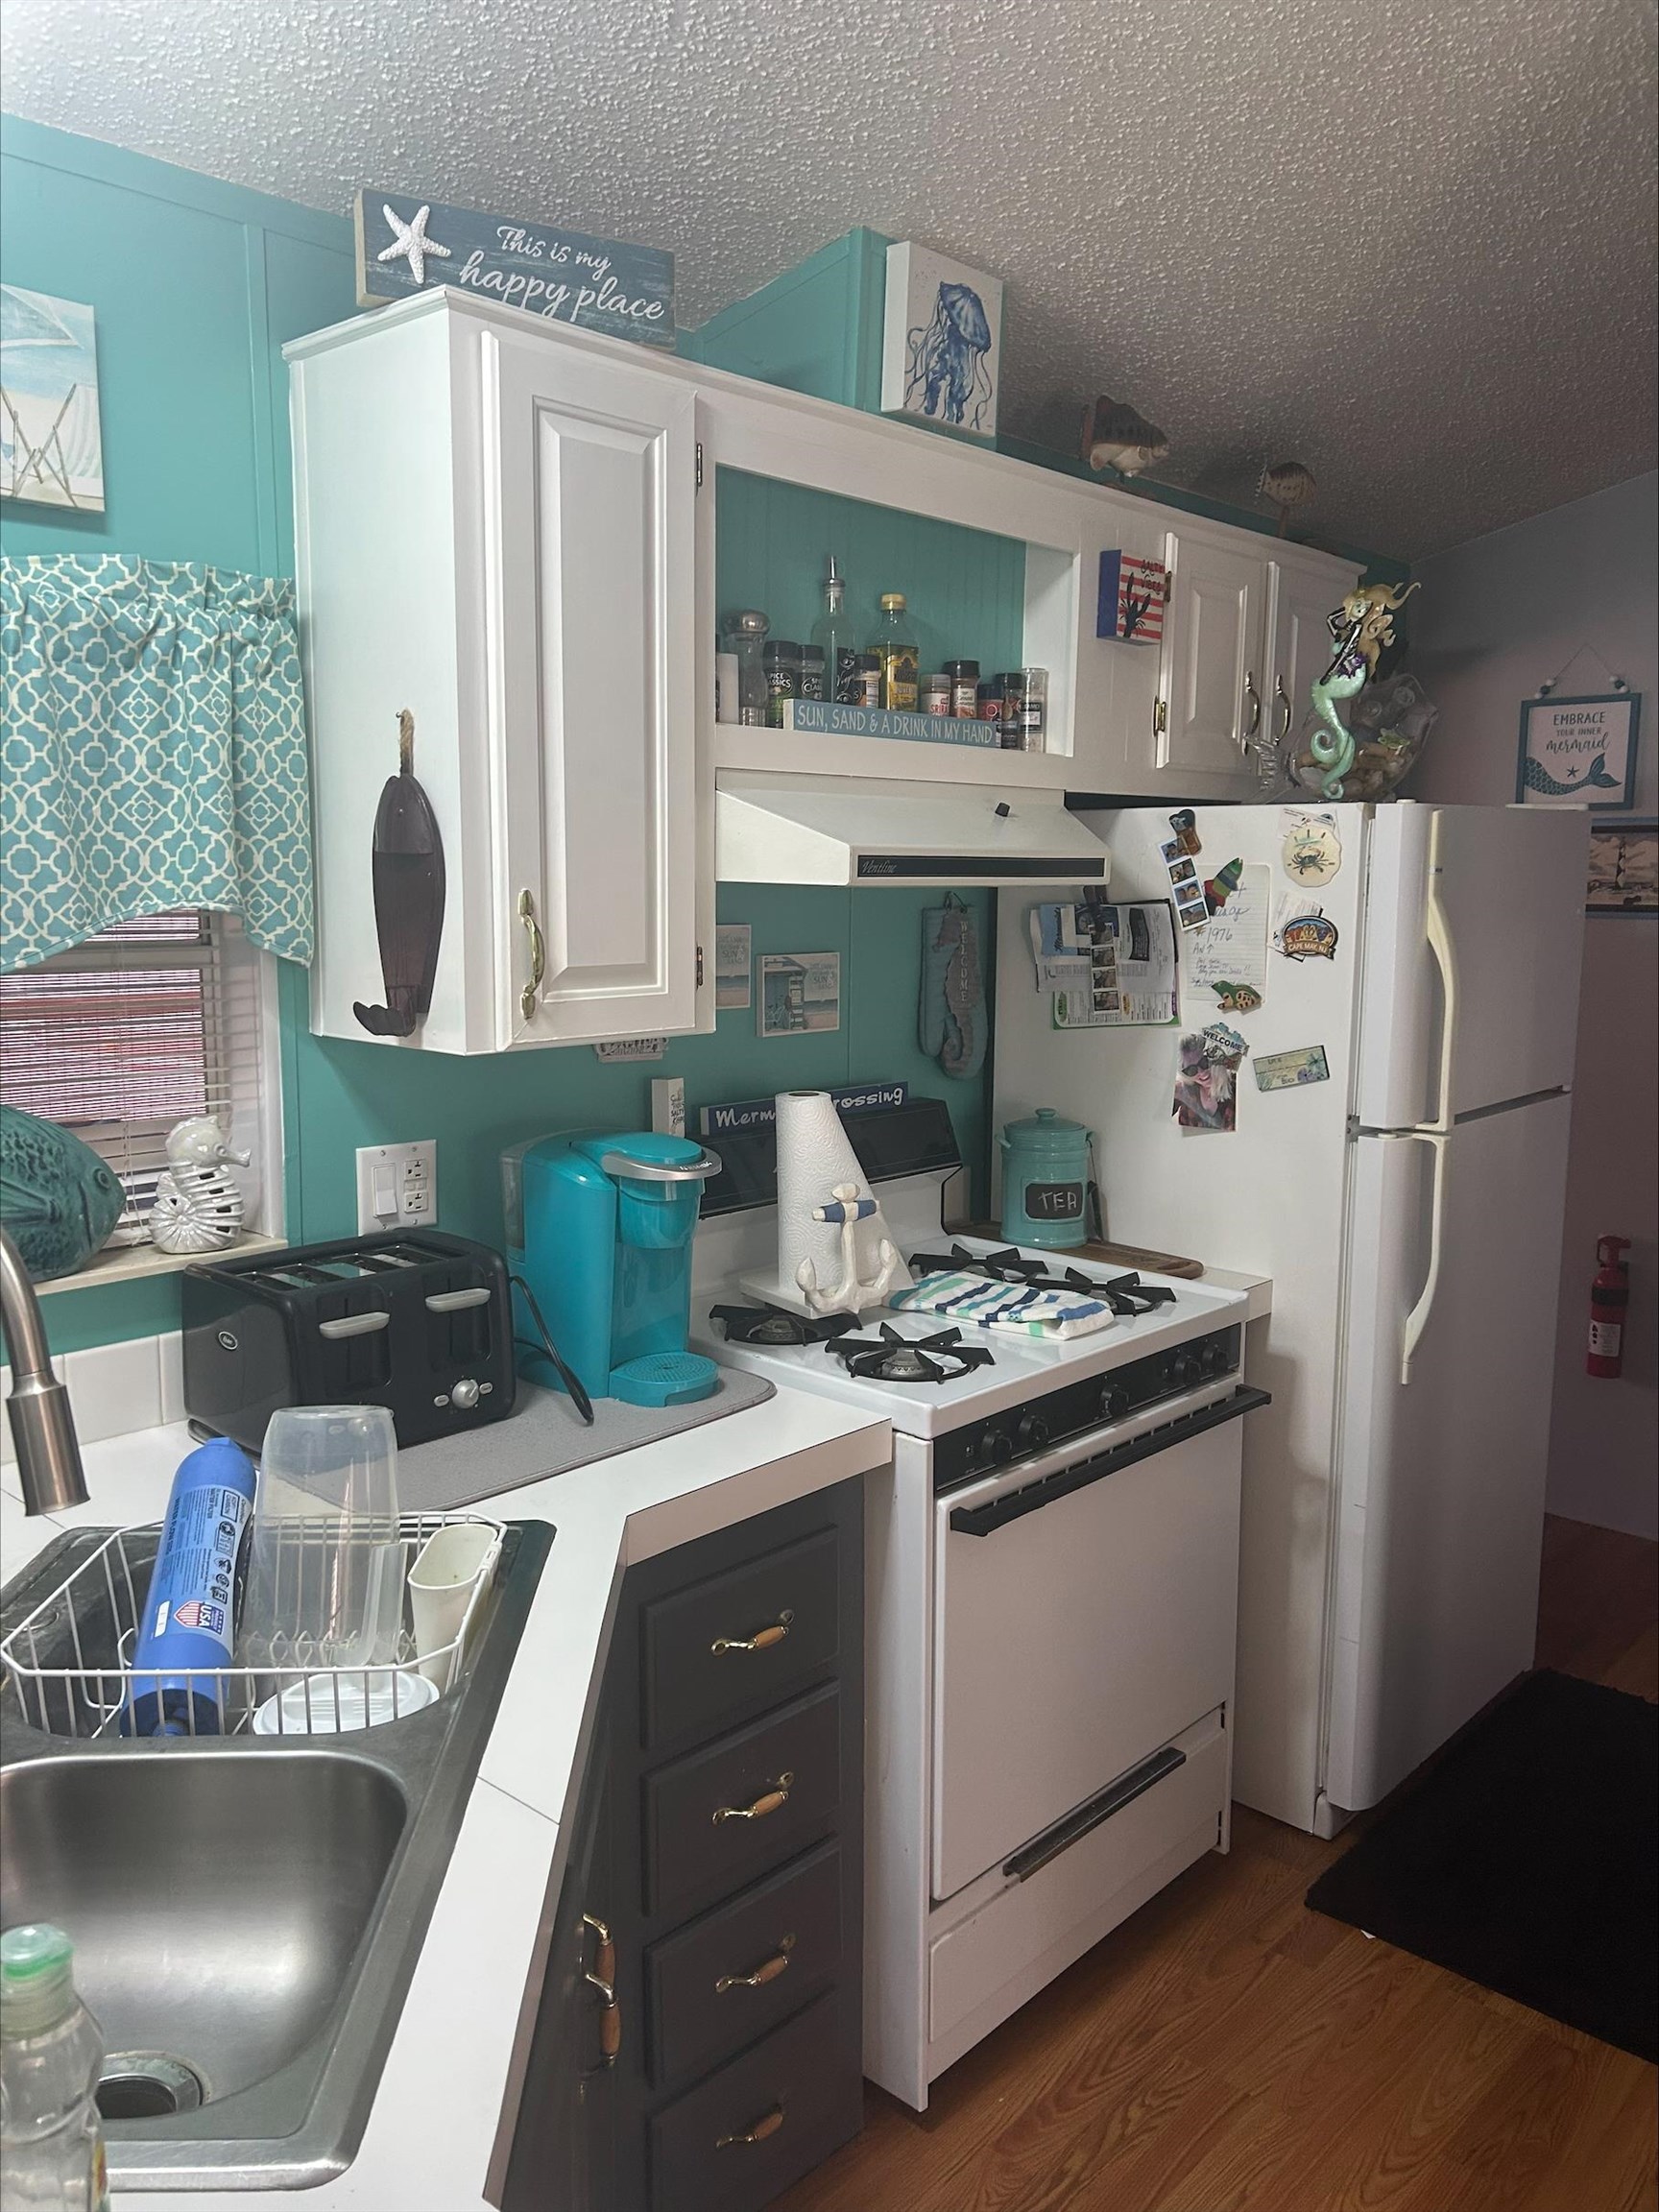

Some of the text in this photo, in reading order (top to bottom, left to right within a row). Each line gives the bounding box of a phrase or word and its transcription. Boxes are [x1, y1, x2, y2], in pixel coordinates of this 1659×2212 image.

[496, 225, 612, 281] This is my
[459, 251, 665, 323] happy place
[797, 705, 829, 733] SUN,
[831, 709, 866, 732] SAND
[870, 713, 878, 733] &
[881, 714, 891, 734] A
[894, 715, 928, 738] DRINK
[931, 722, 941, 738] IN
[944, 723, 960, 741] MY
[962, 725, 993, 744] HAND
[1552, 711, 1606, 726] EMBRACE
[1546, 731, 1611, 755] mermaid
[1556, 727, 1602, 737] YOUR INNER
[1287, 943, 1304, 951] CAPE
[960, 920, 969, 1001] WELCOME
[1202, 1029, 1244, 1052] WELCOME
[715, 1087, 903, 1128] Merm rossing
[1037, 1190, 1077, 1211] TEA
[198, 1604, 212, 1627] USA
